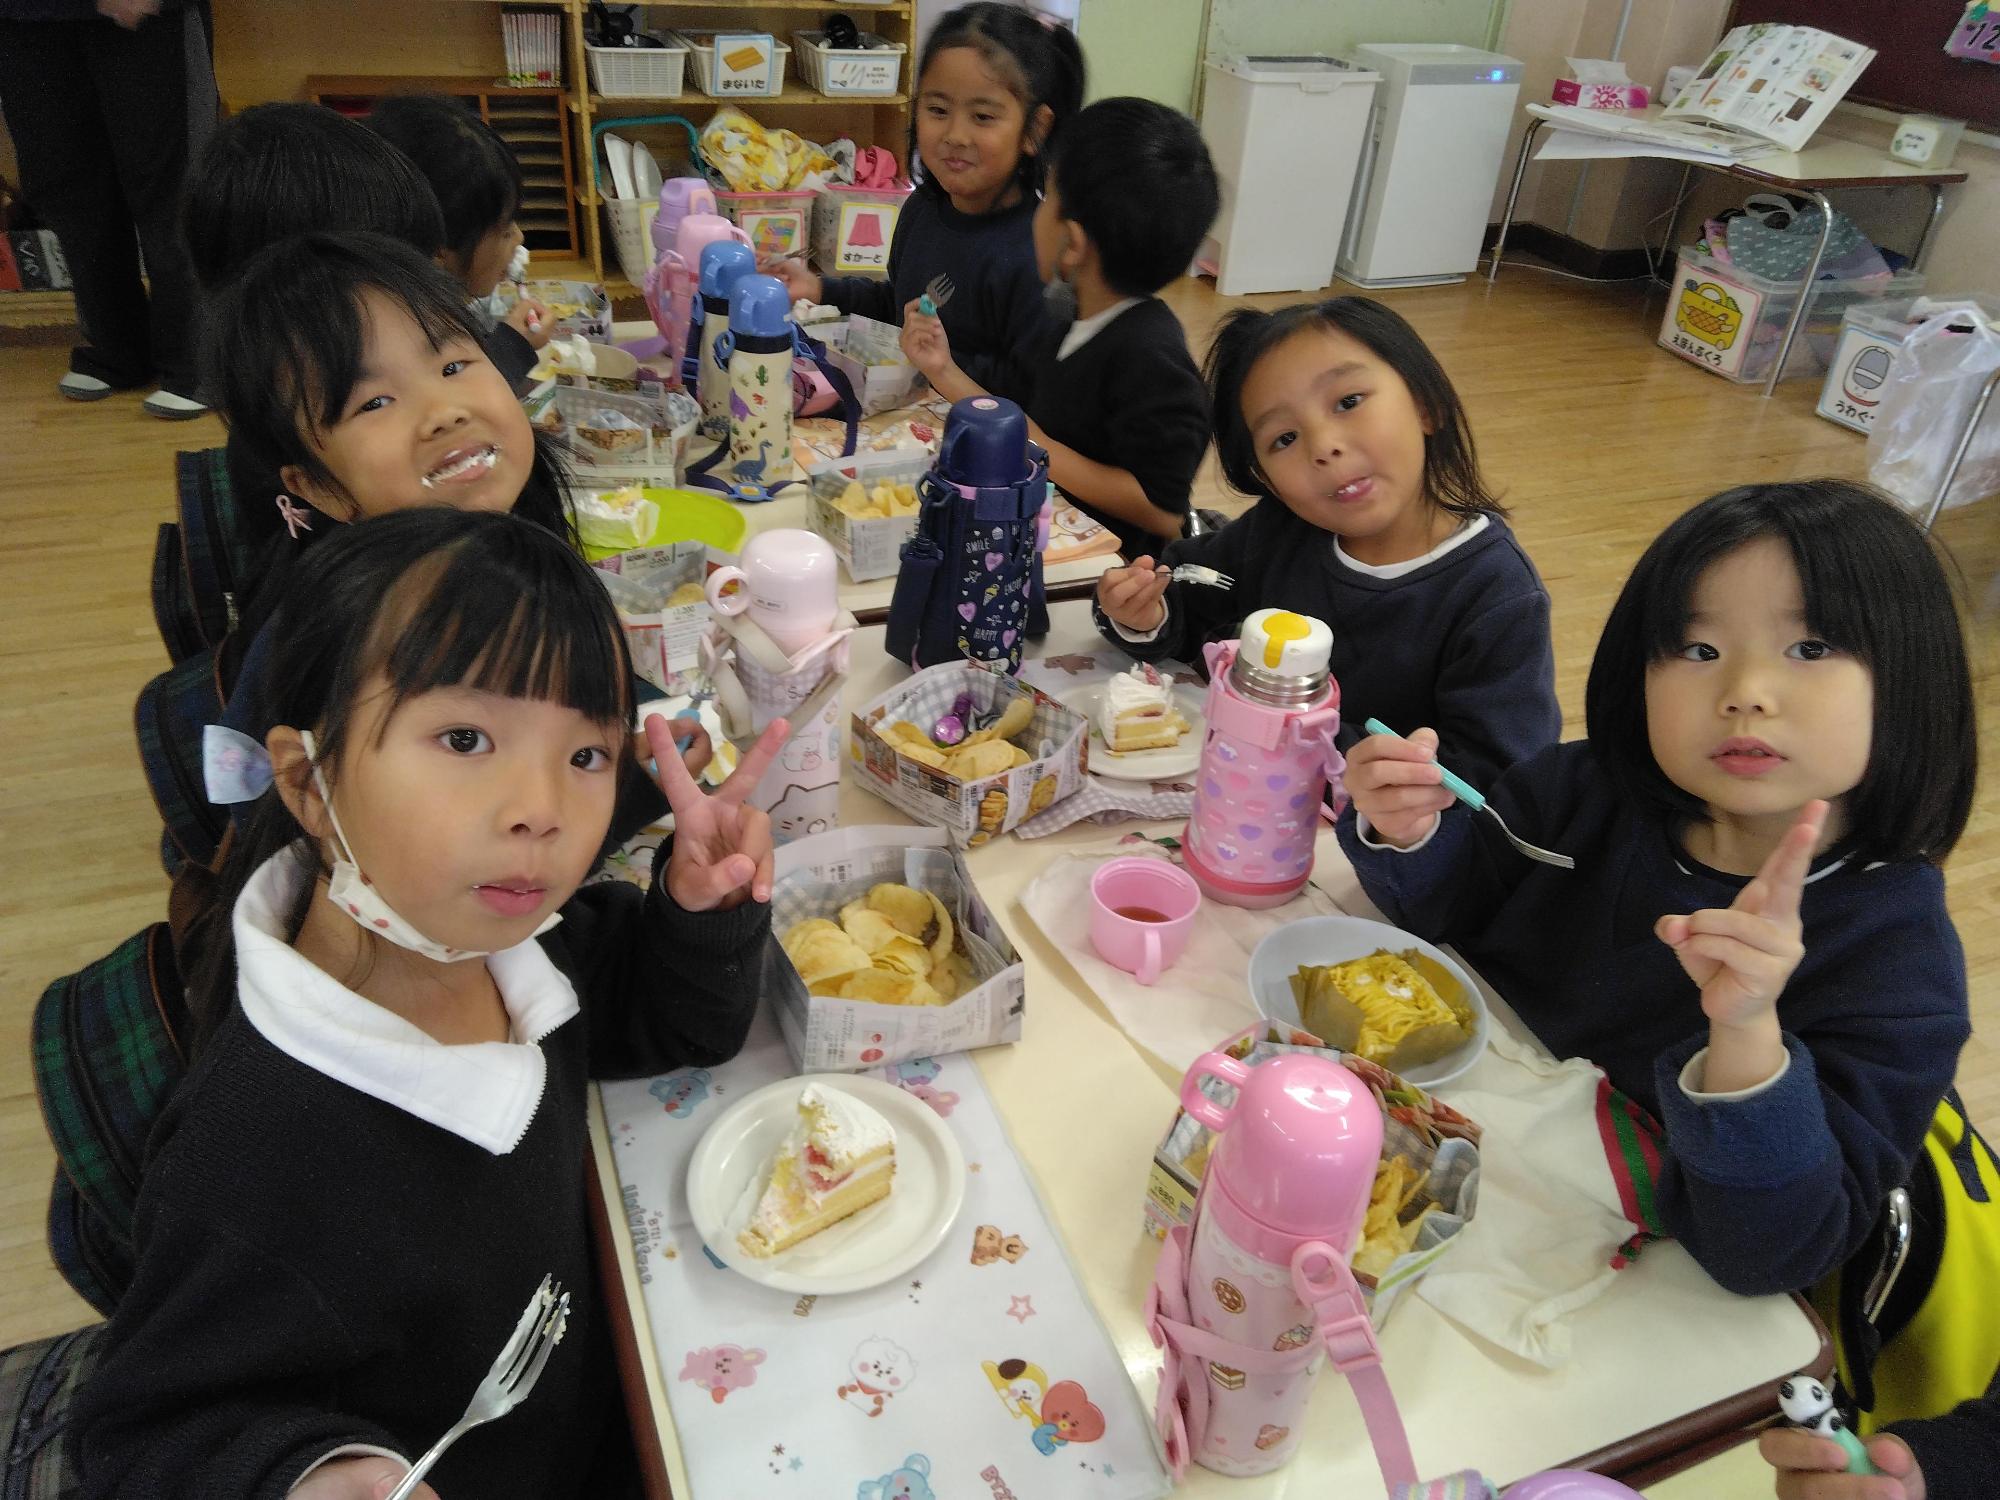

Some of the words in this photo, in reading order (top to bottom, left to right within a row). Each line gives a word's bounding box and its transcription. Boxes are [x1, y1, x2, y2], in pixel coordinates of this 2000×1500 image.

[722, 79, 765, 90] まないた
[844, 253, 883, 264] すかーと
[1835, 400, 1875, 424] うわぐ
[965, 537, 991, 554] SMILE
[973, 628, 998, 641] HAPPY
[980, 1464, 1018, 1500] BT2
